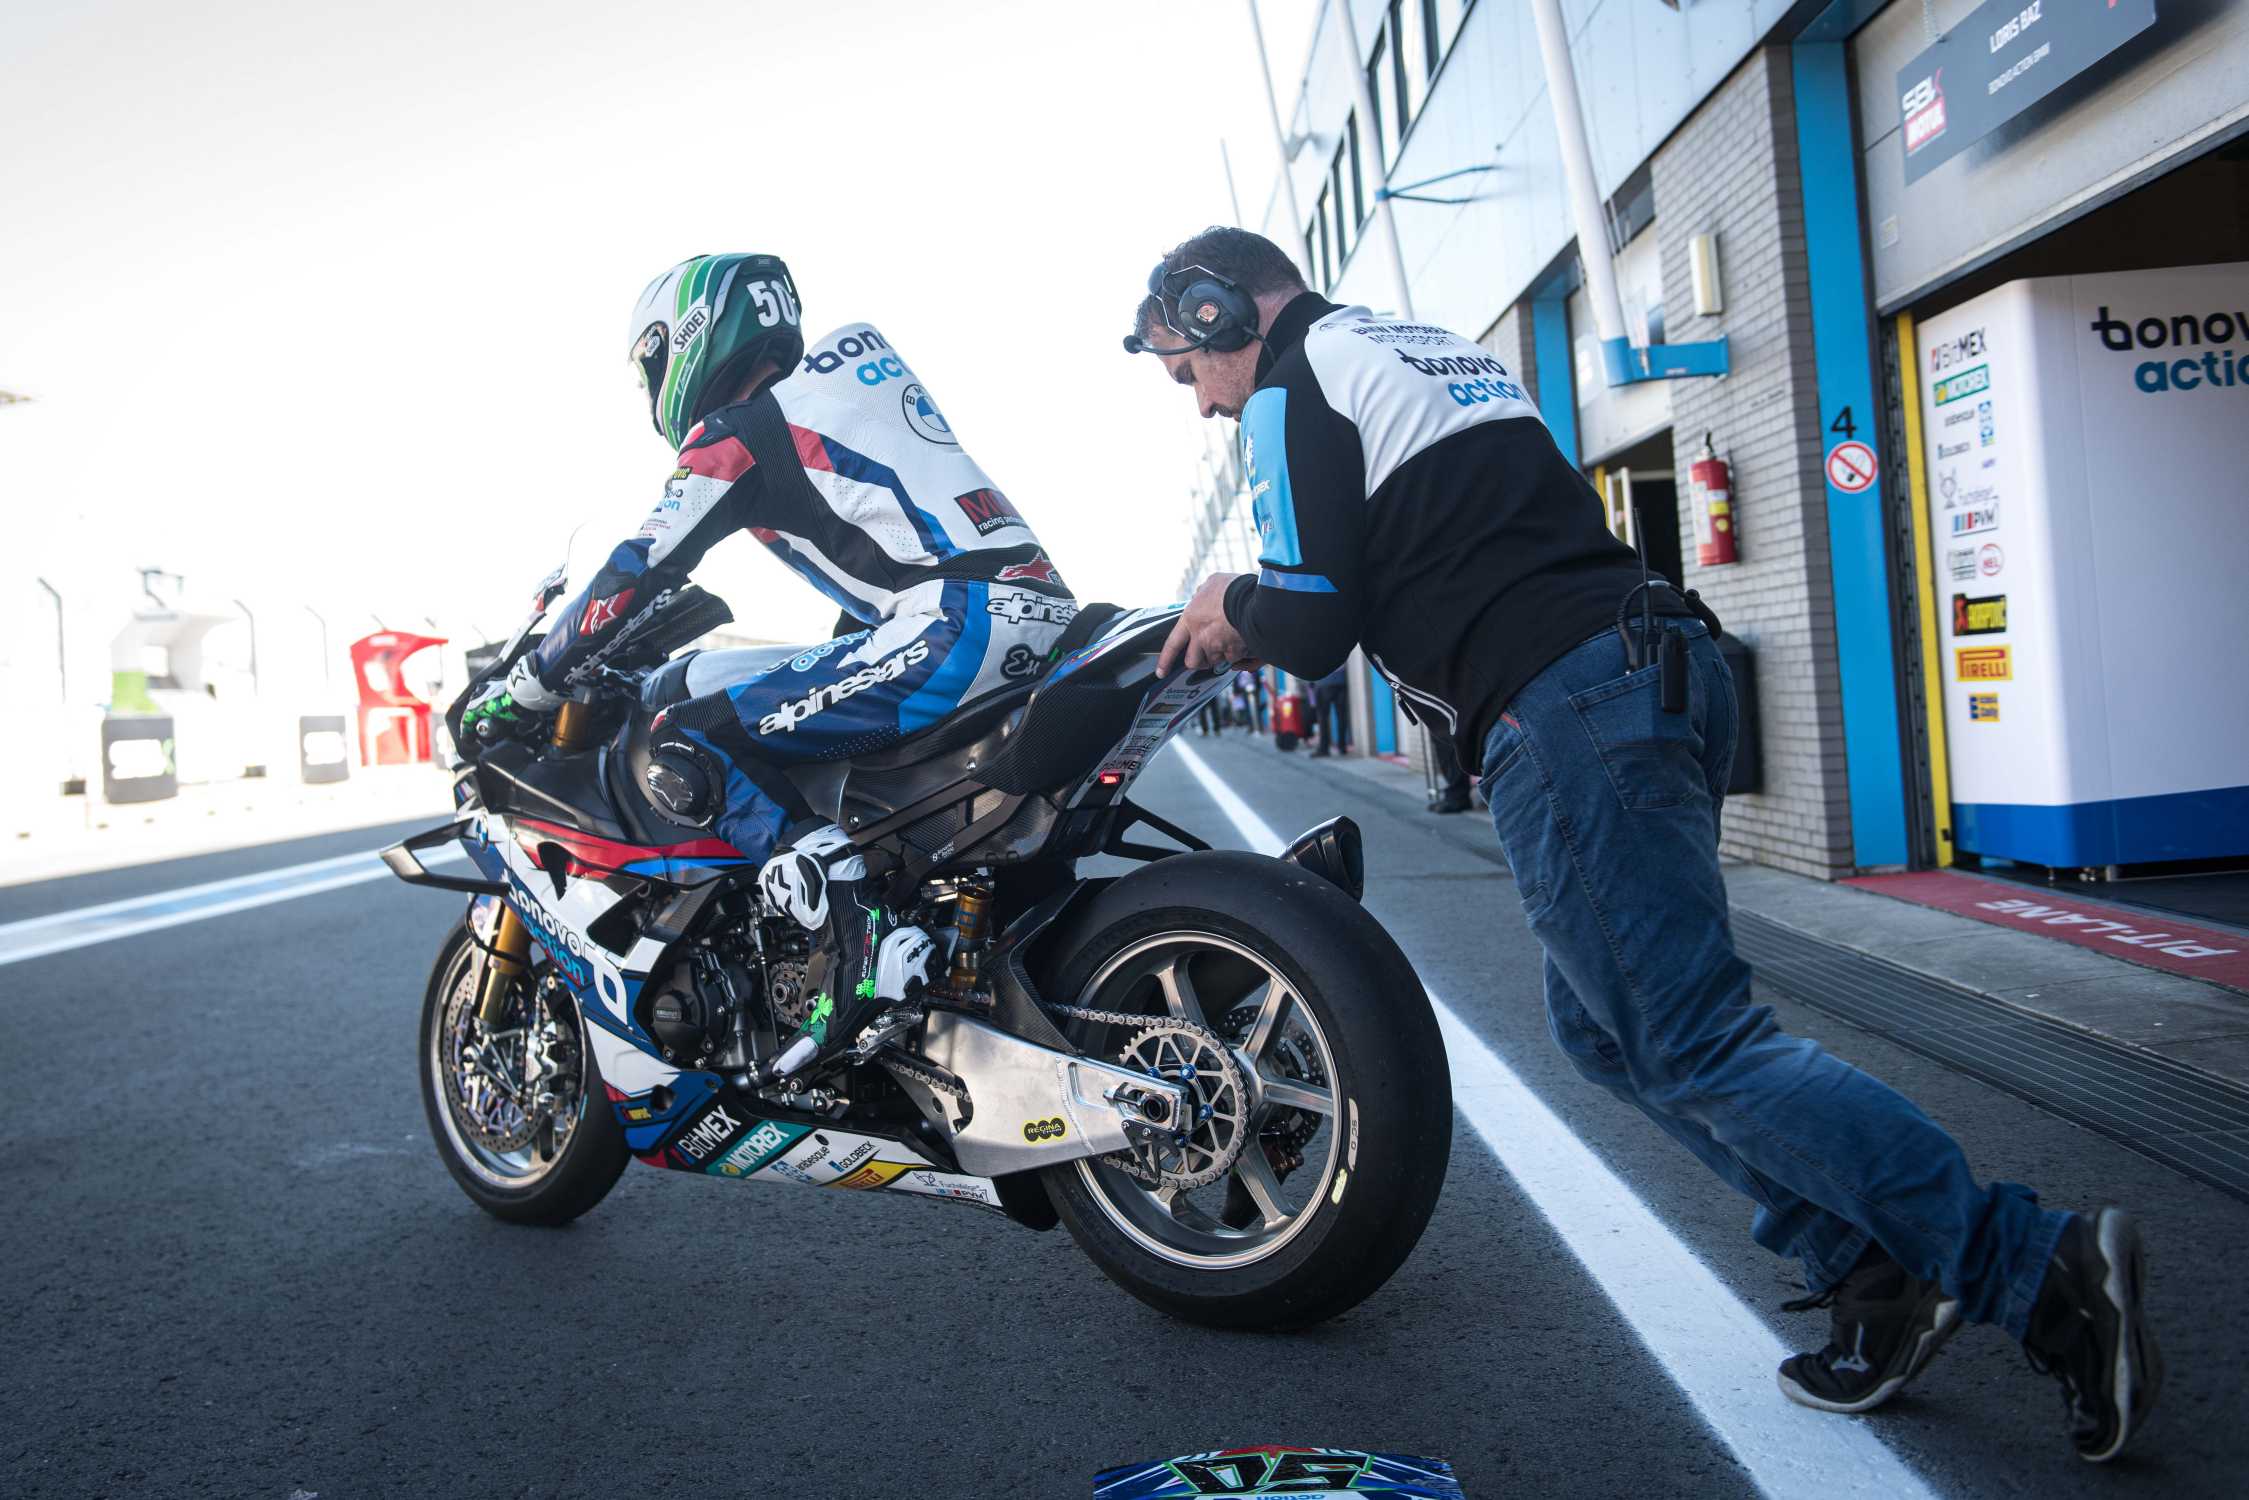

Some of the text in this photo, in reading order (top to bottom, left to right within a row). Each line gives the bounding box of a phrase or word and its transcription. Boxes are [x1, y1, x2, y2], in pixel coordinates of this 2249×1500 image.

[746, 280, 798, 328] 50
[674, 310, 706, 350] SHOEI
[1368, 335, 1455, 346] MOTORSPORT
[1394, 348, 1507, 377] bonovo
[1831, 405, 1857, 439] 4
[978, 517, 1006, 531] racing
[1958, 649, 2007, 678] PIRELLI
[759, 639, 929, 735] alpinestars
[678, 1104, 742, 1159] BitMEX
[1027, 1122, 1061, 1135] REGINA
[726, 1122, 790, 1171] MOTOREX
[838, 1140, 876, 1168] GOLDBECK
